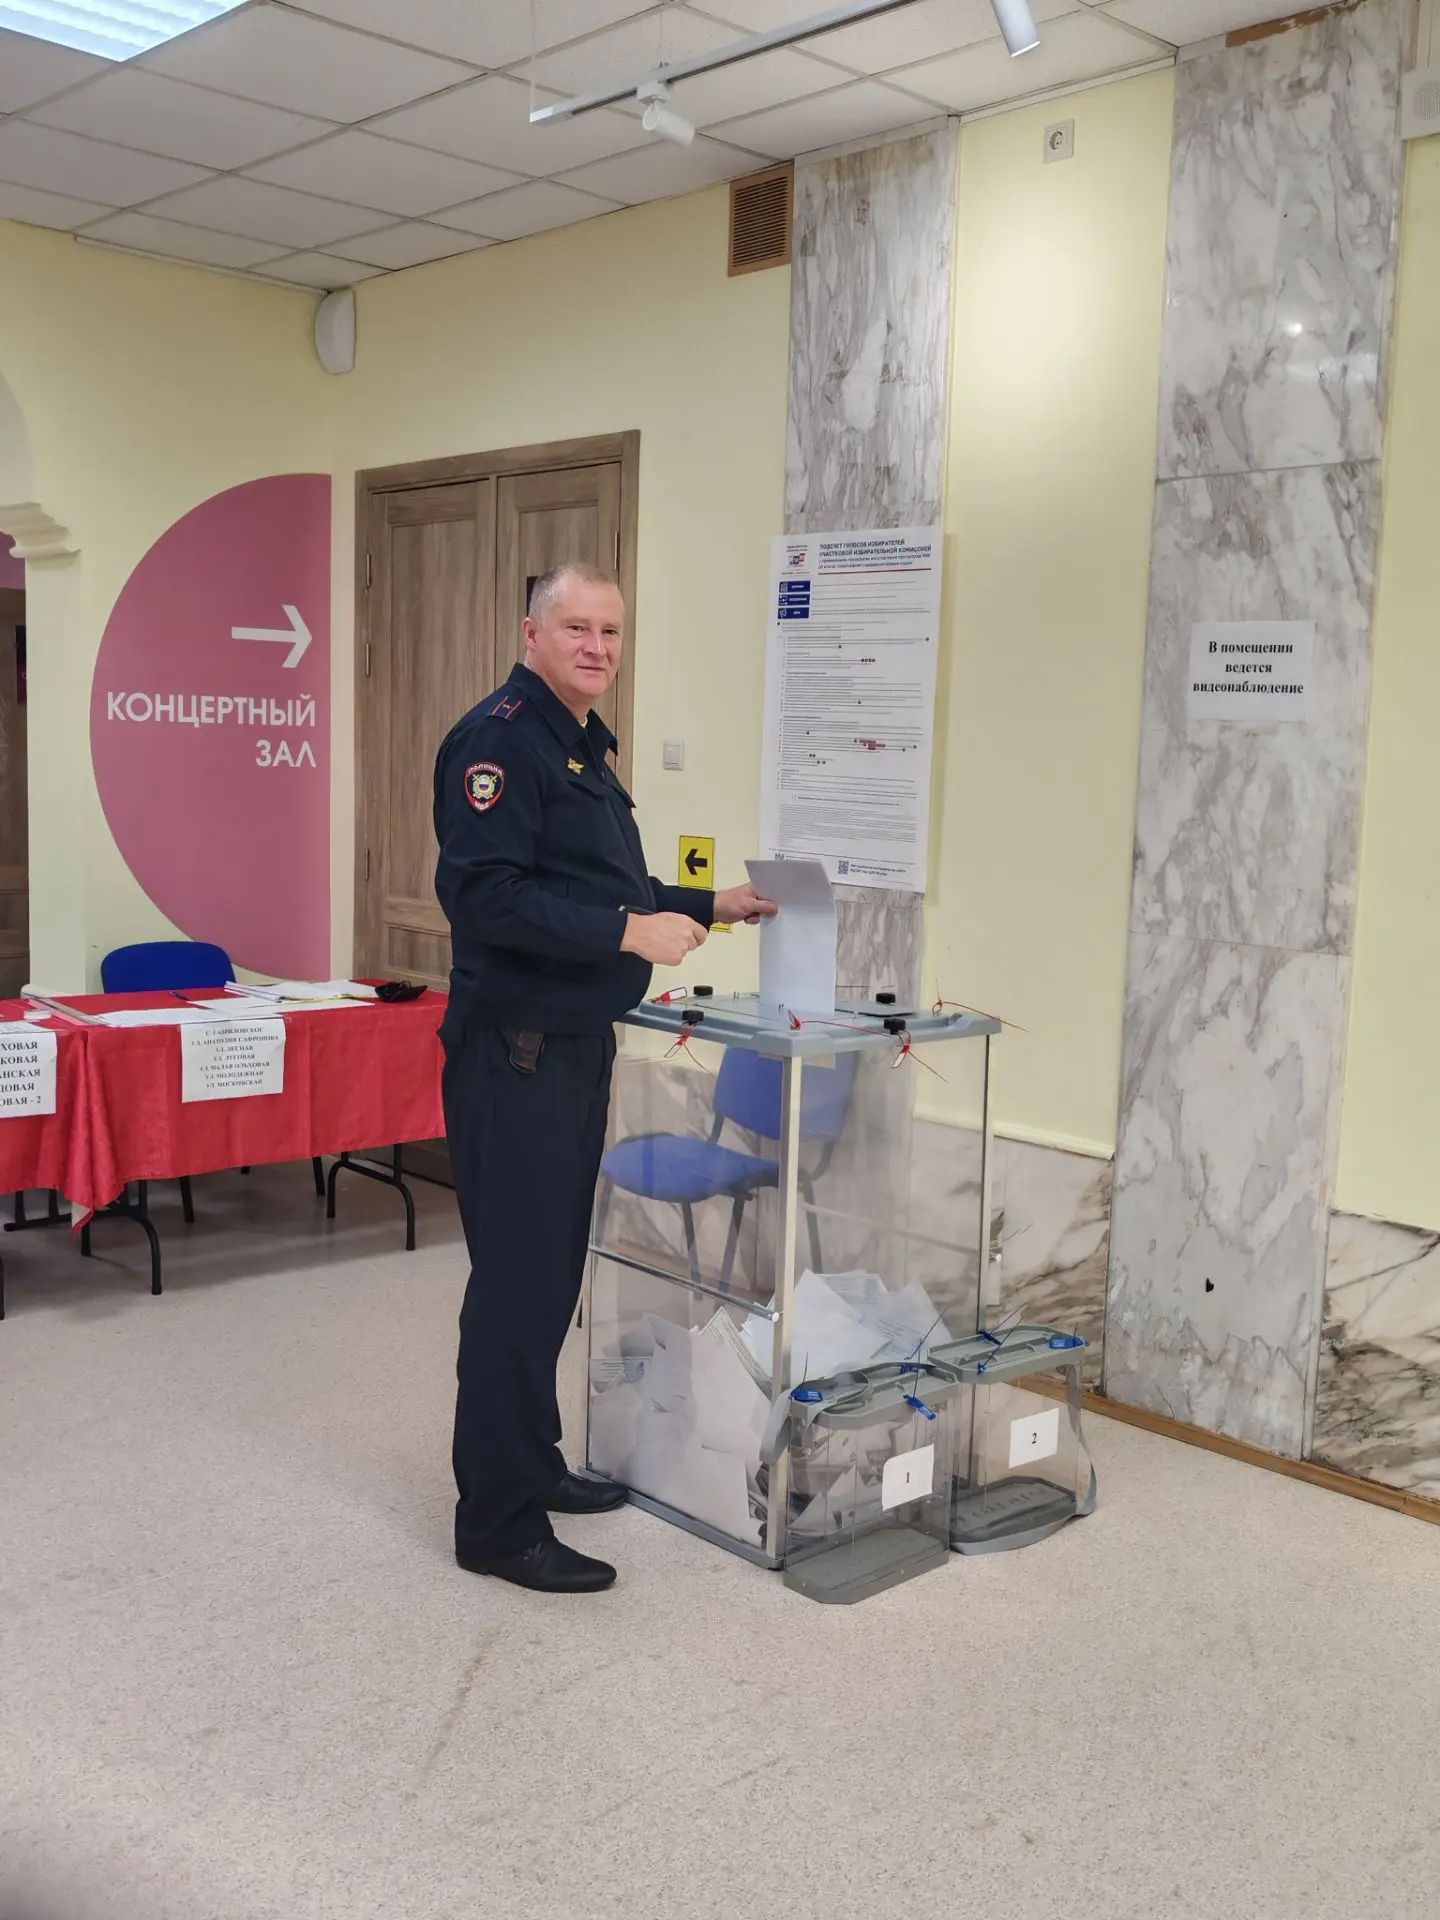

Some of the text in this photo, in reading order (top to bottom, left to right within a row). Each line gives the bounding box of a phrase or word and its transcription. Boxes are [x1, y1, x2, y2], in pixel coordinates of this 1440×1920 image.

[867, 538, 905, 547] ИЗБИРАТЕЛЕЙ
[853, 546, 898, 555] ИЗБИРАТЕЛЬНОЙ
[1208, 641, 1294, 654] В помещении
[1225, 664, 1273, 674] ведется
[1193, 680, 1304, 695] видеонаблюдение
[107, 691, 316, 729] КОНЦЕРТНЫЙ
[255, 739, 317, 768] ЗАЛ
[0, 1069, 40, 1078] НСКАЯ
[37, 1096, 41, 1104] 2
[1031, 1432, 1038, 1445] 2
